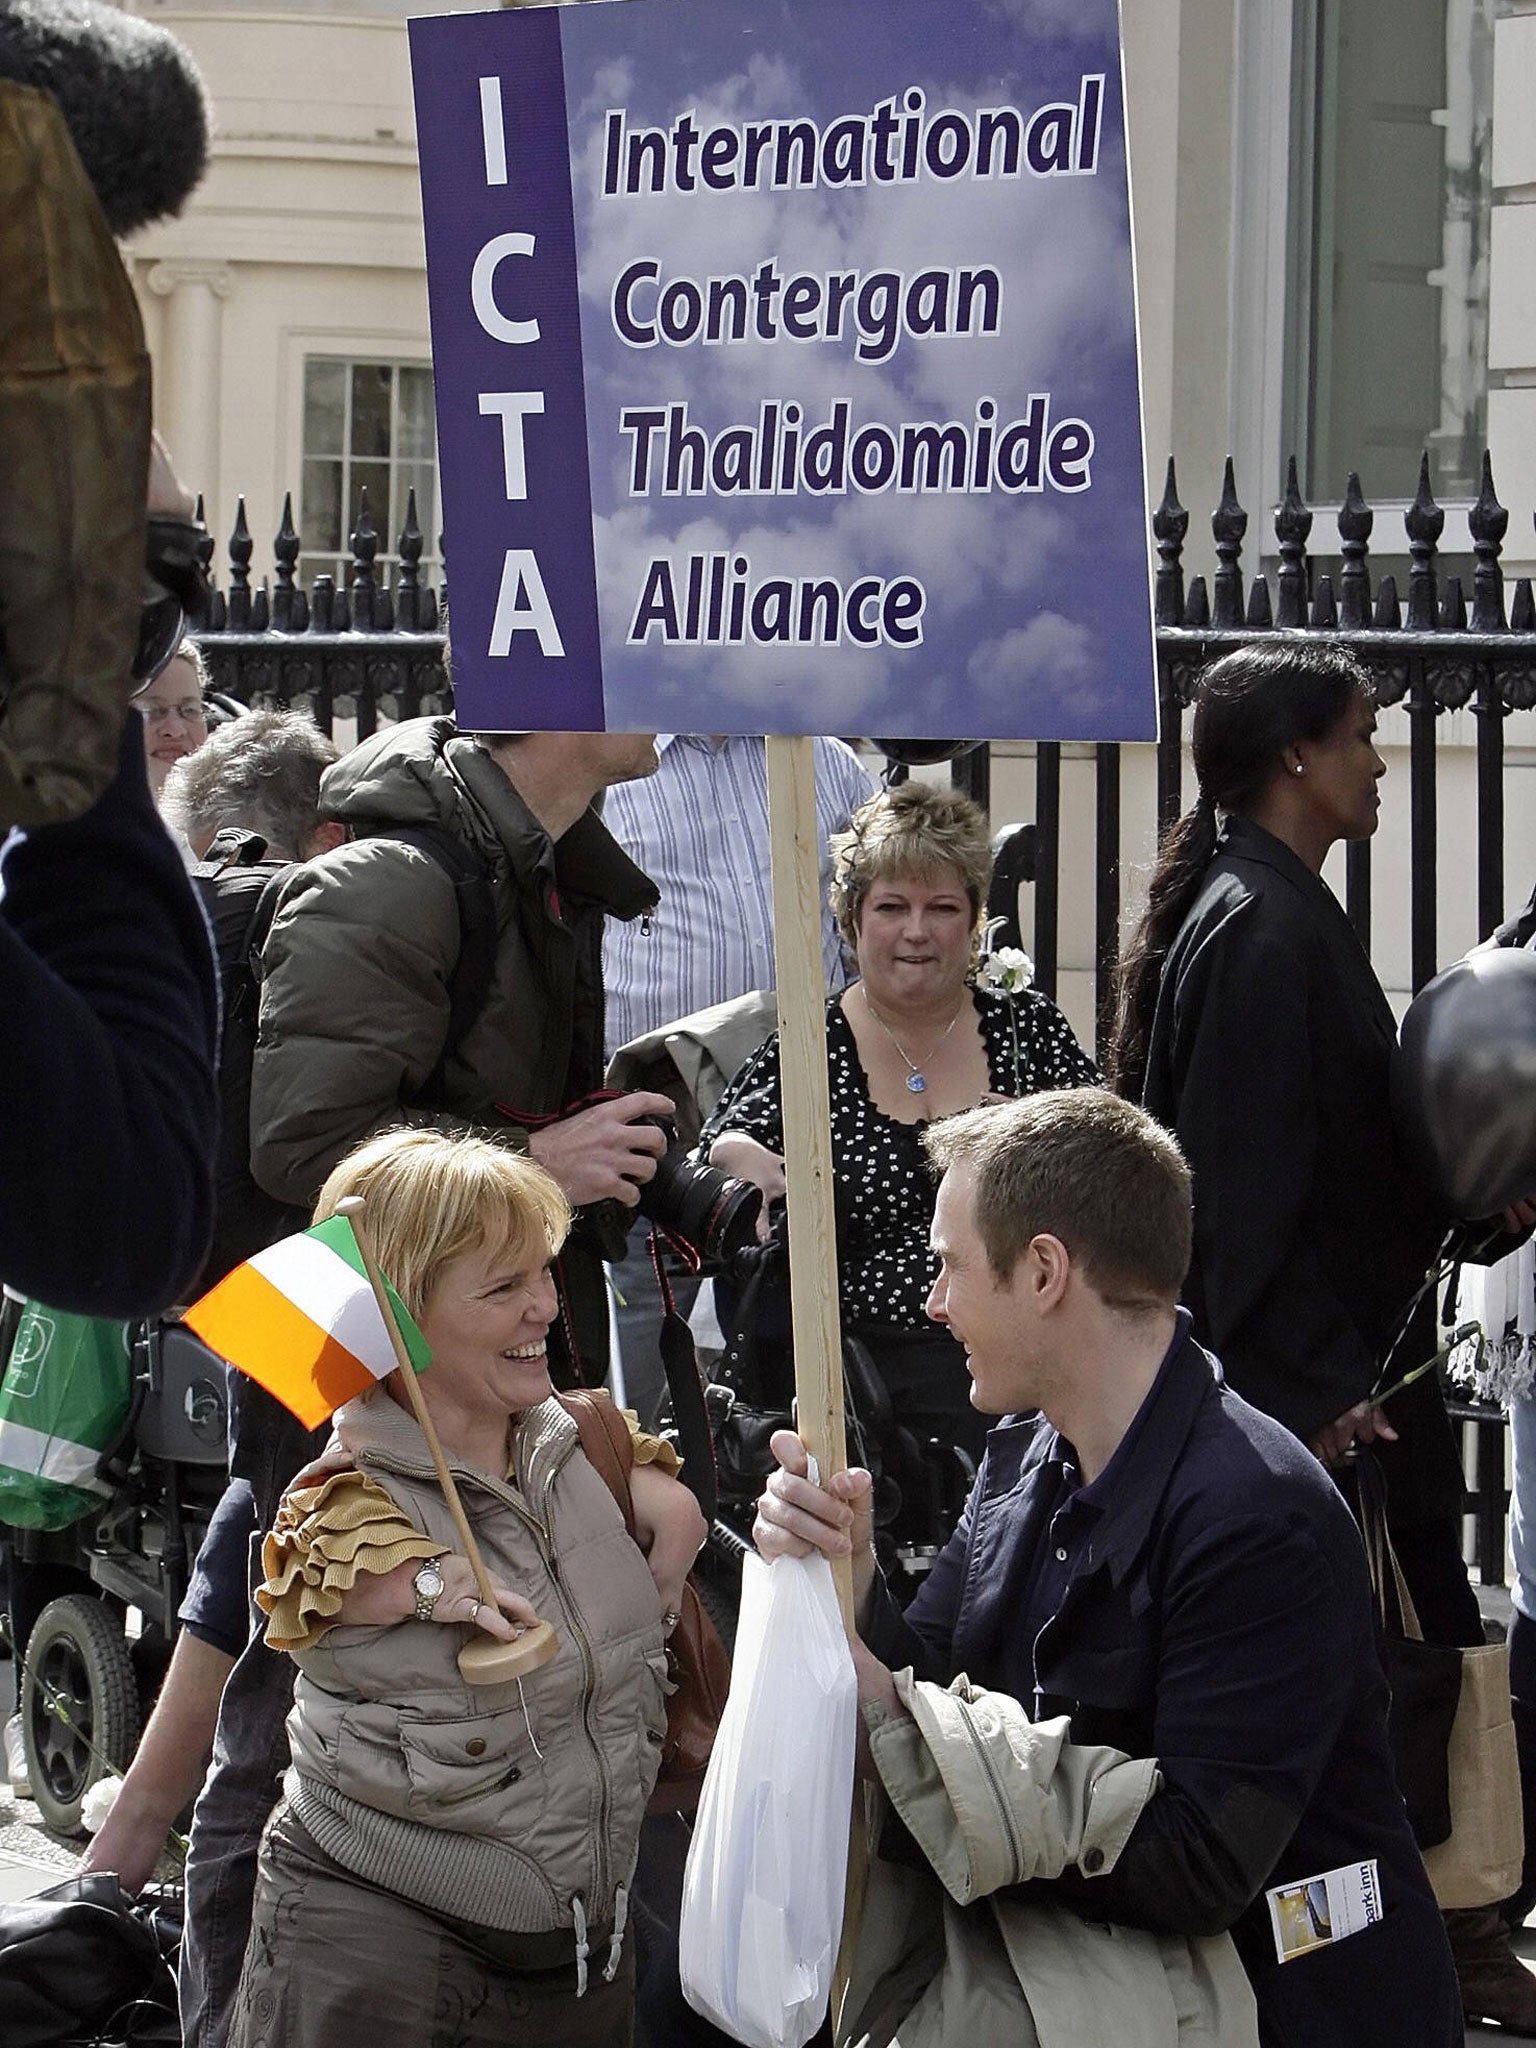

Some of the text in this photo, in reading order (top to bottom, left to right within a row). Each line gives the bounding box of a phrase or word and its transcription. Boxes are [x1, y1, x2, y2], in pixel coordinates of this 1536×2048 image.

[601, 74, 1106, 197] International
[610, 257, 1003, 365] Contergan
[619, 393, 1096, 498] Thalidomide
[626, 551, 927, 649] Alliance
[1360, 1865, 1371, 1890] inn
